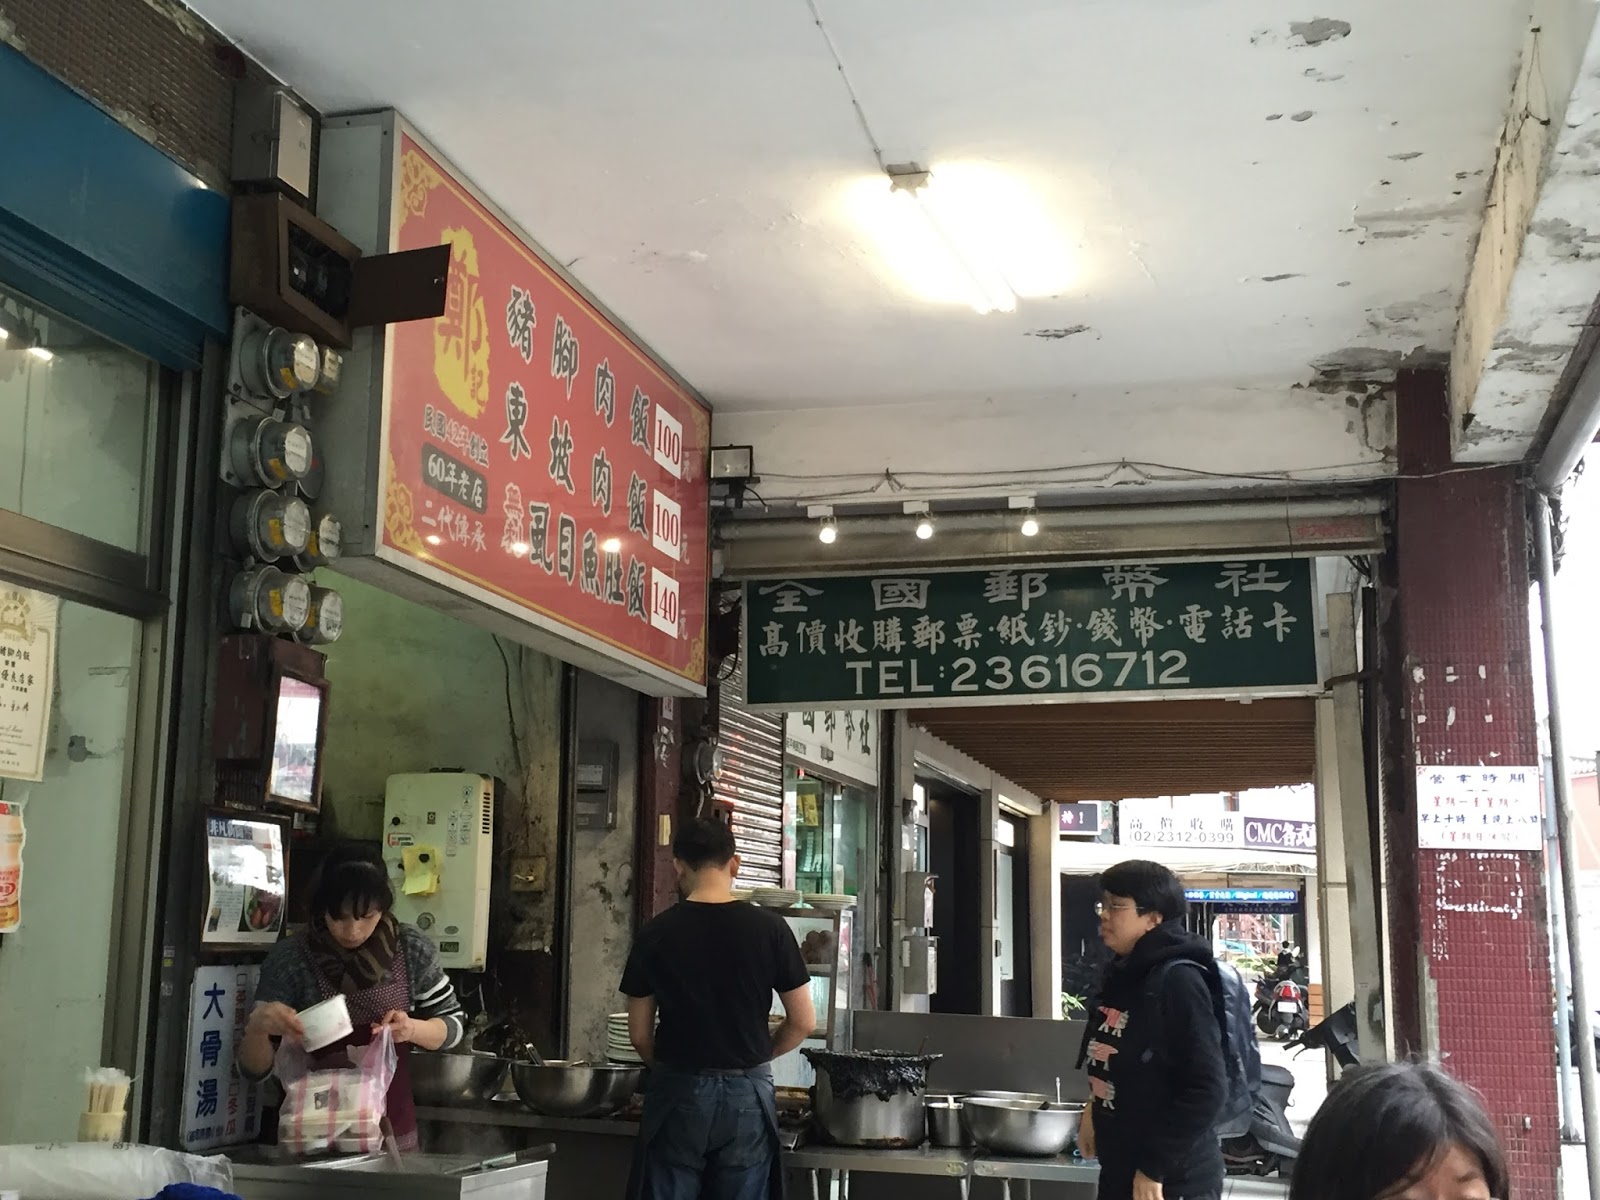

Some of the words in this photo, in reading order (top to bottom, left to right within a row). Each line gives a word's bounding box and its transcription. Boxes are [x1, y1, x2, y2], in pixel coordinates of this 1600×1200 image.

[505, 283, 651, 454] 豬腳肉飯
[656, 417, 681, 467] 100
[428, 453, 484, 508] 60年老店
[499, 382, 649, 540] 東坡肉飯
[654, 502, 679, 548] 100
[421, 499, 487, 552] 二代傳承
[528, 500, 649, 624] 虱目魚肚飯
[652, 580, 677, 624] 140
[759, 562, 1293, 614] 全國郵幣社
[846, 650, 1190, 695] TEL:23616712
[195, 982, 226, 1118] 大骨湯
